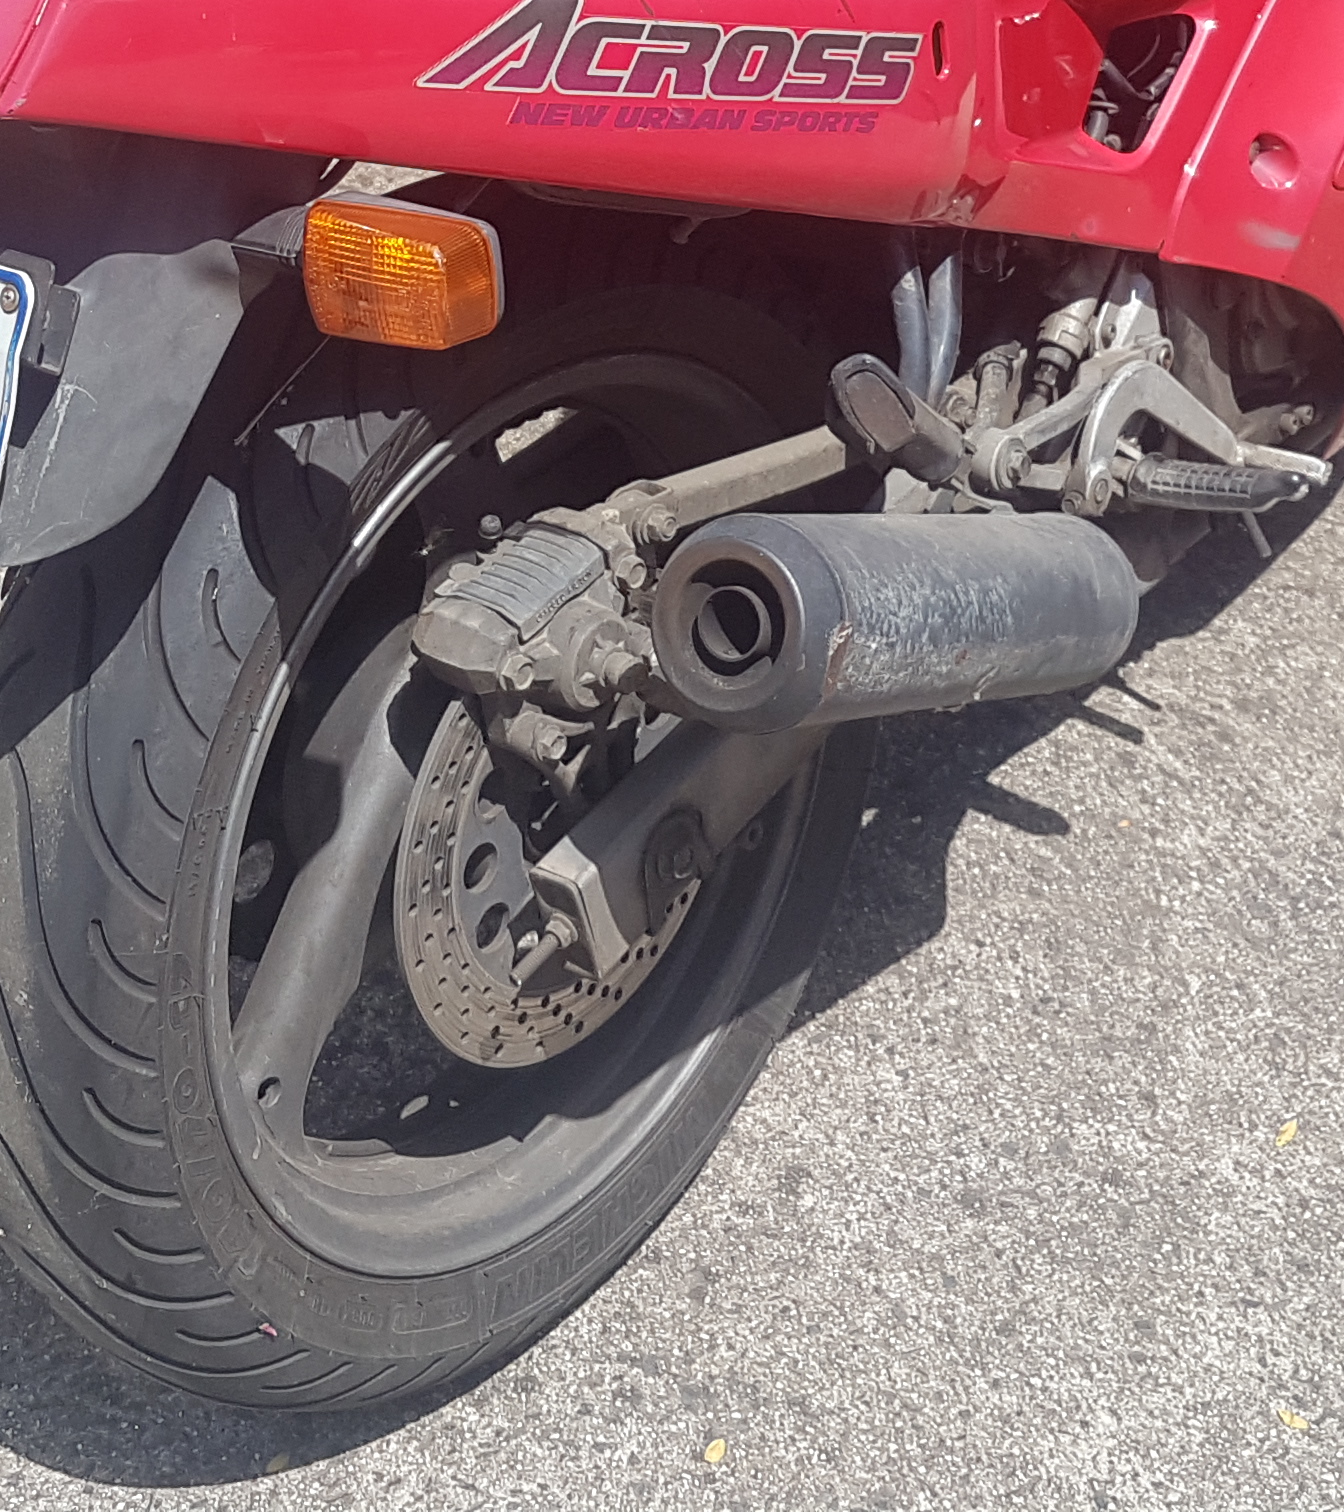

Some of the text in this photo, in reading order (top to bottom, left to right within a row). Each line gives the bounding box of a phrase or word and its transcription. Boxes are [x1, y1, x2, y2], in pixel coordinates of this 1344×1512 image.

[510, 101, 879, 134] NEW URBAN SPORTS
